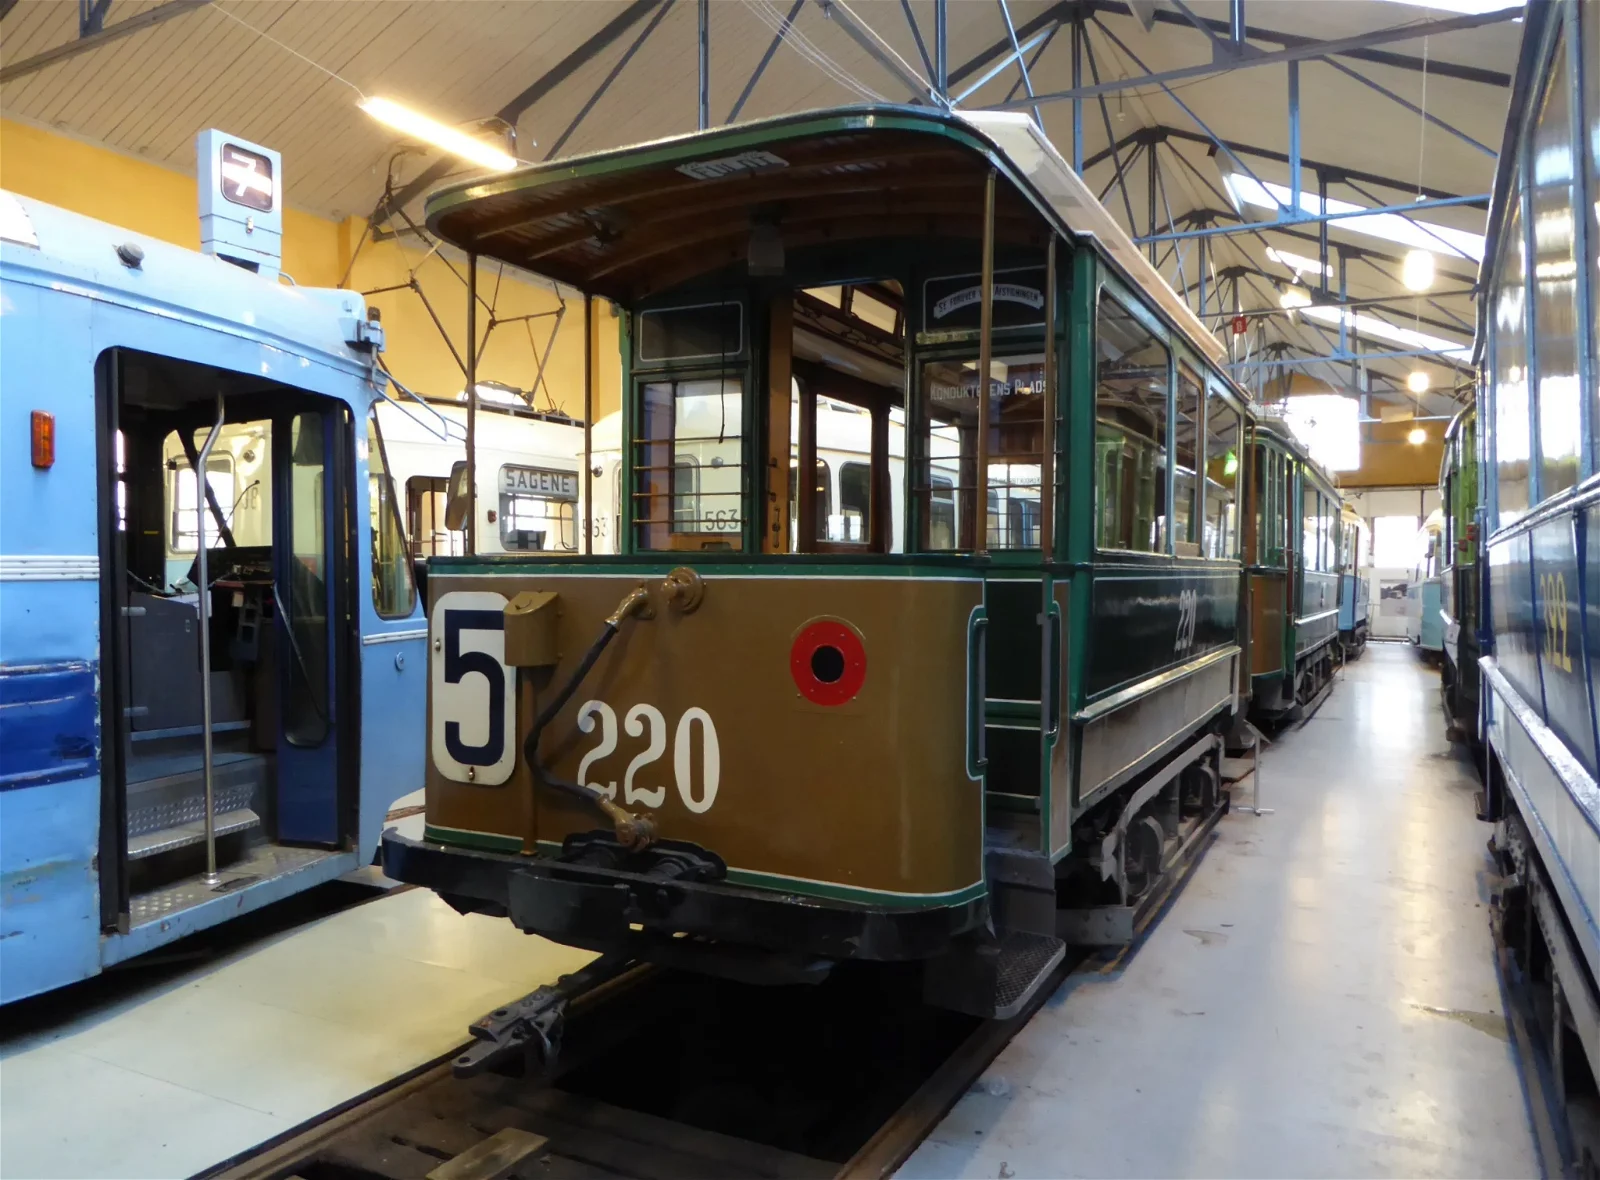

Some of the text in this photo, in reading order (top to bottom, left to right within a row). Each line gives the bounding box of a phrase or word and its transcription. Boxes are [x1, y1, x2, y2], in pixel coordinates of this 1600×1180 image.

[231, 151, 257, 197] 7
[506, 470, 570, 493] SAGENE
[705, 509, 738, 531] 563
[1174, 589, 1197, 652] 220
[444, 609, 506, 767] 5
[577, 700, 720, 814] 220
